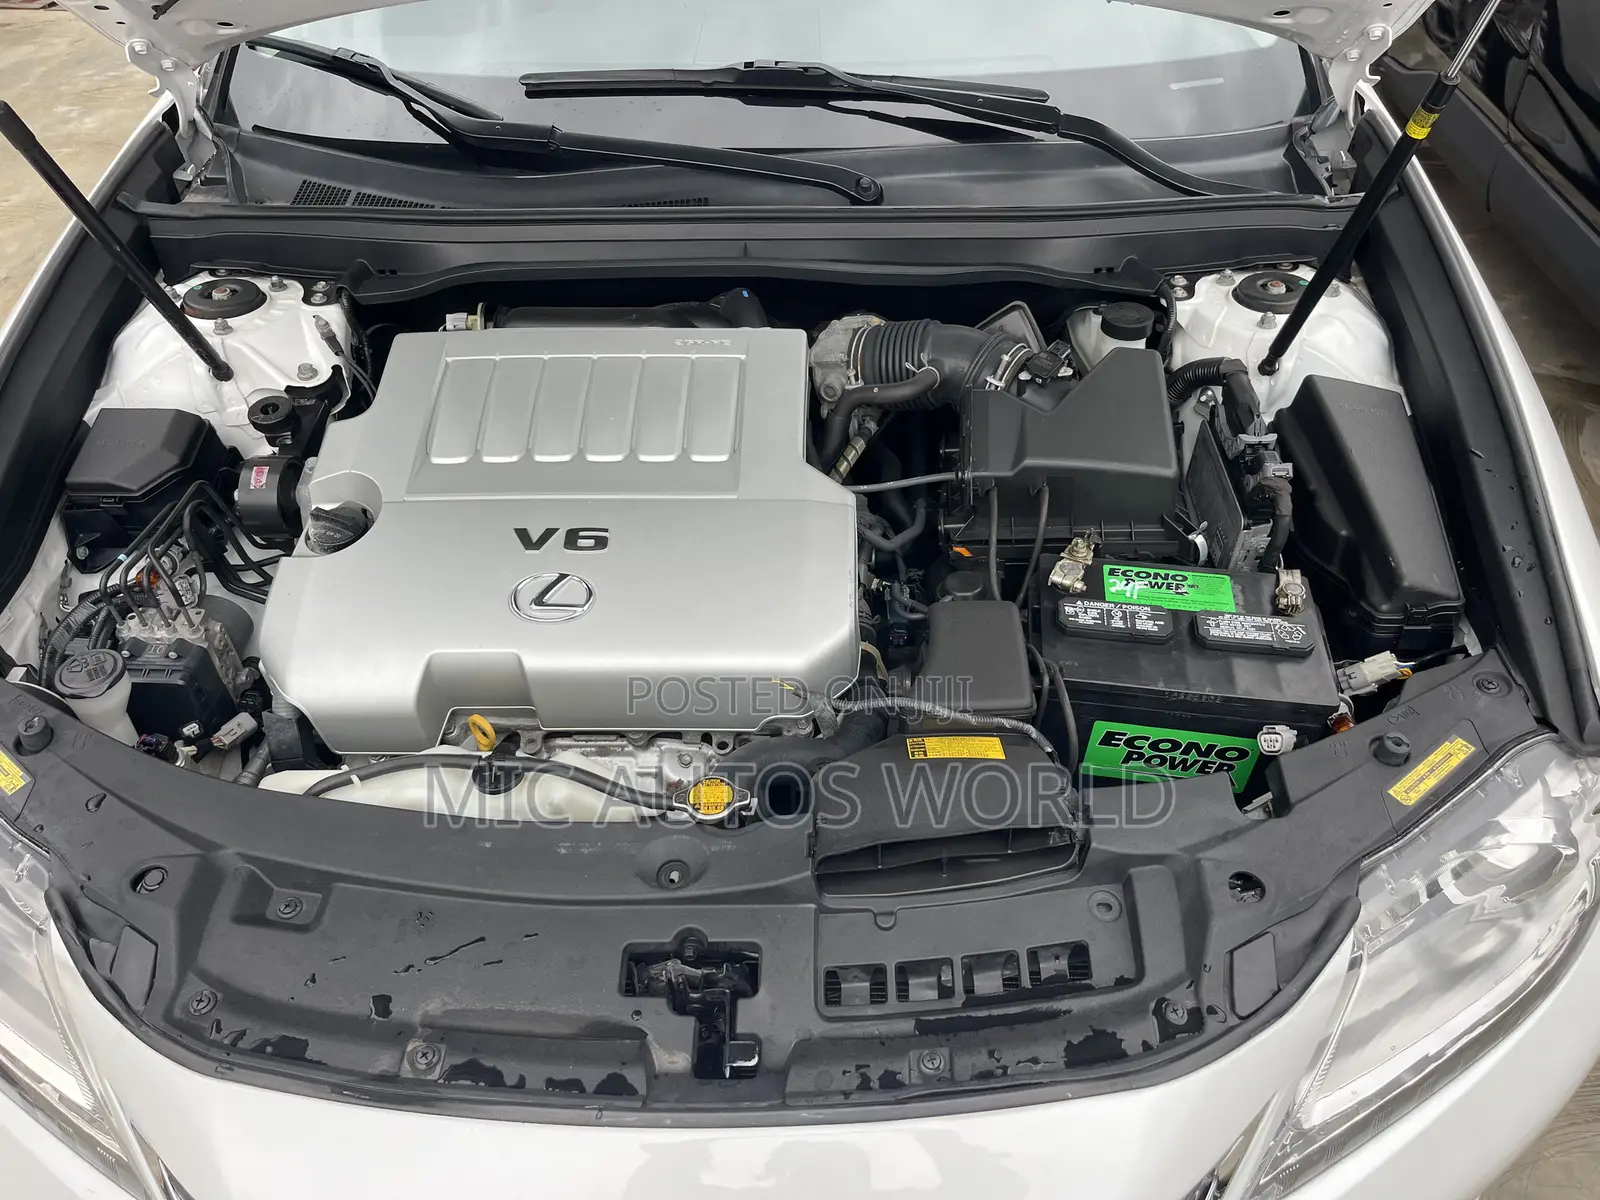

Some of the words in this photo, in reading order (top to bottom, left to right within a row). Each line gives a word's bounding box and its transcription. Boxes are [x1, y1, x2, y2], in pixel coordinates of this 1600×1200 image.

[513, 527, 609, 551] V6
[1107, 567, 1188, 582] ECONO
[1124, 578, 1187, 593] PWER
[1084, 600, 1114, 609] DANGER
[1122, 604, 1151, 612] POISON
[1096, 729, 1252, 762] ECONO
